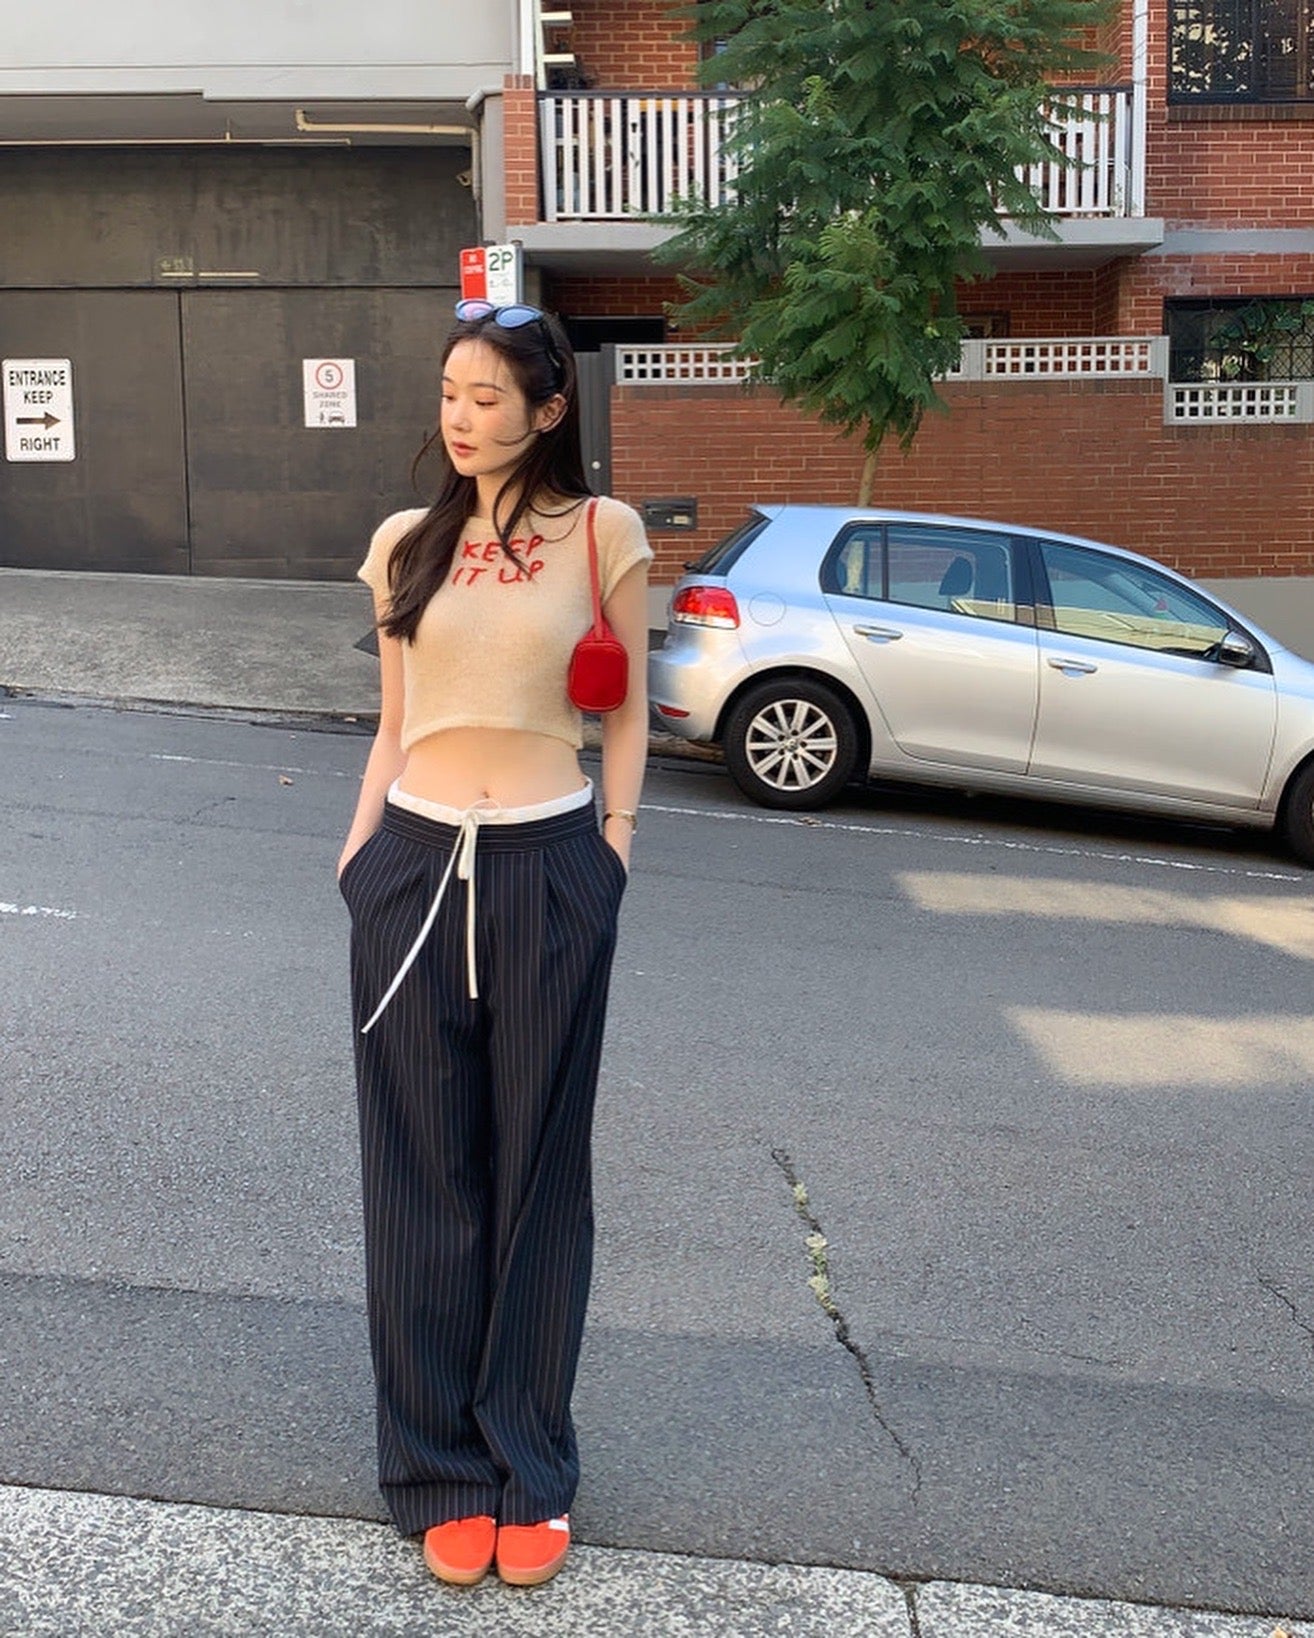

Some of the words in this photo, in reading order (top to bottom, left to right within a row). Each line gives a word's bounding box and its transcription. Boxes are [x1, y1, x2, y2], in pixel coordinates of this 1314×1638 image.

[489, 251, 513, 271] 2P
[9, 370, 66, 386] ENTRANCE
[324, 369, 334, 384] 5
[23, 390, 53, 404] KEEP
[20, 437, 61, 451] RIGHT
[452, 567, 487, 586] IT
[498, 560, 545, 584] UP
